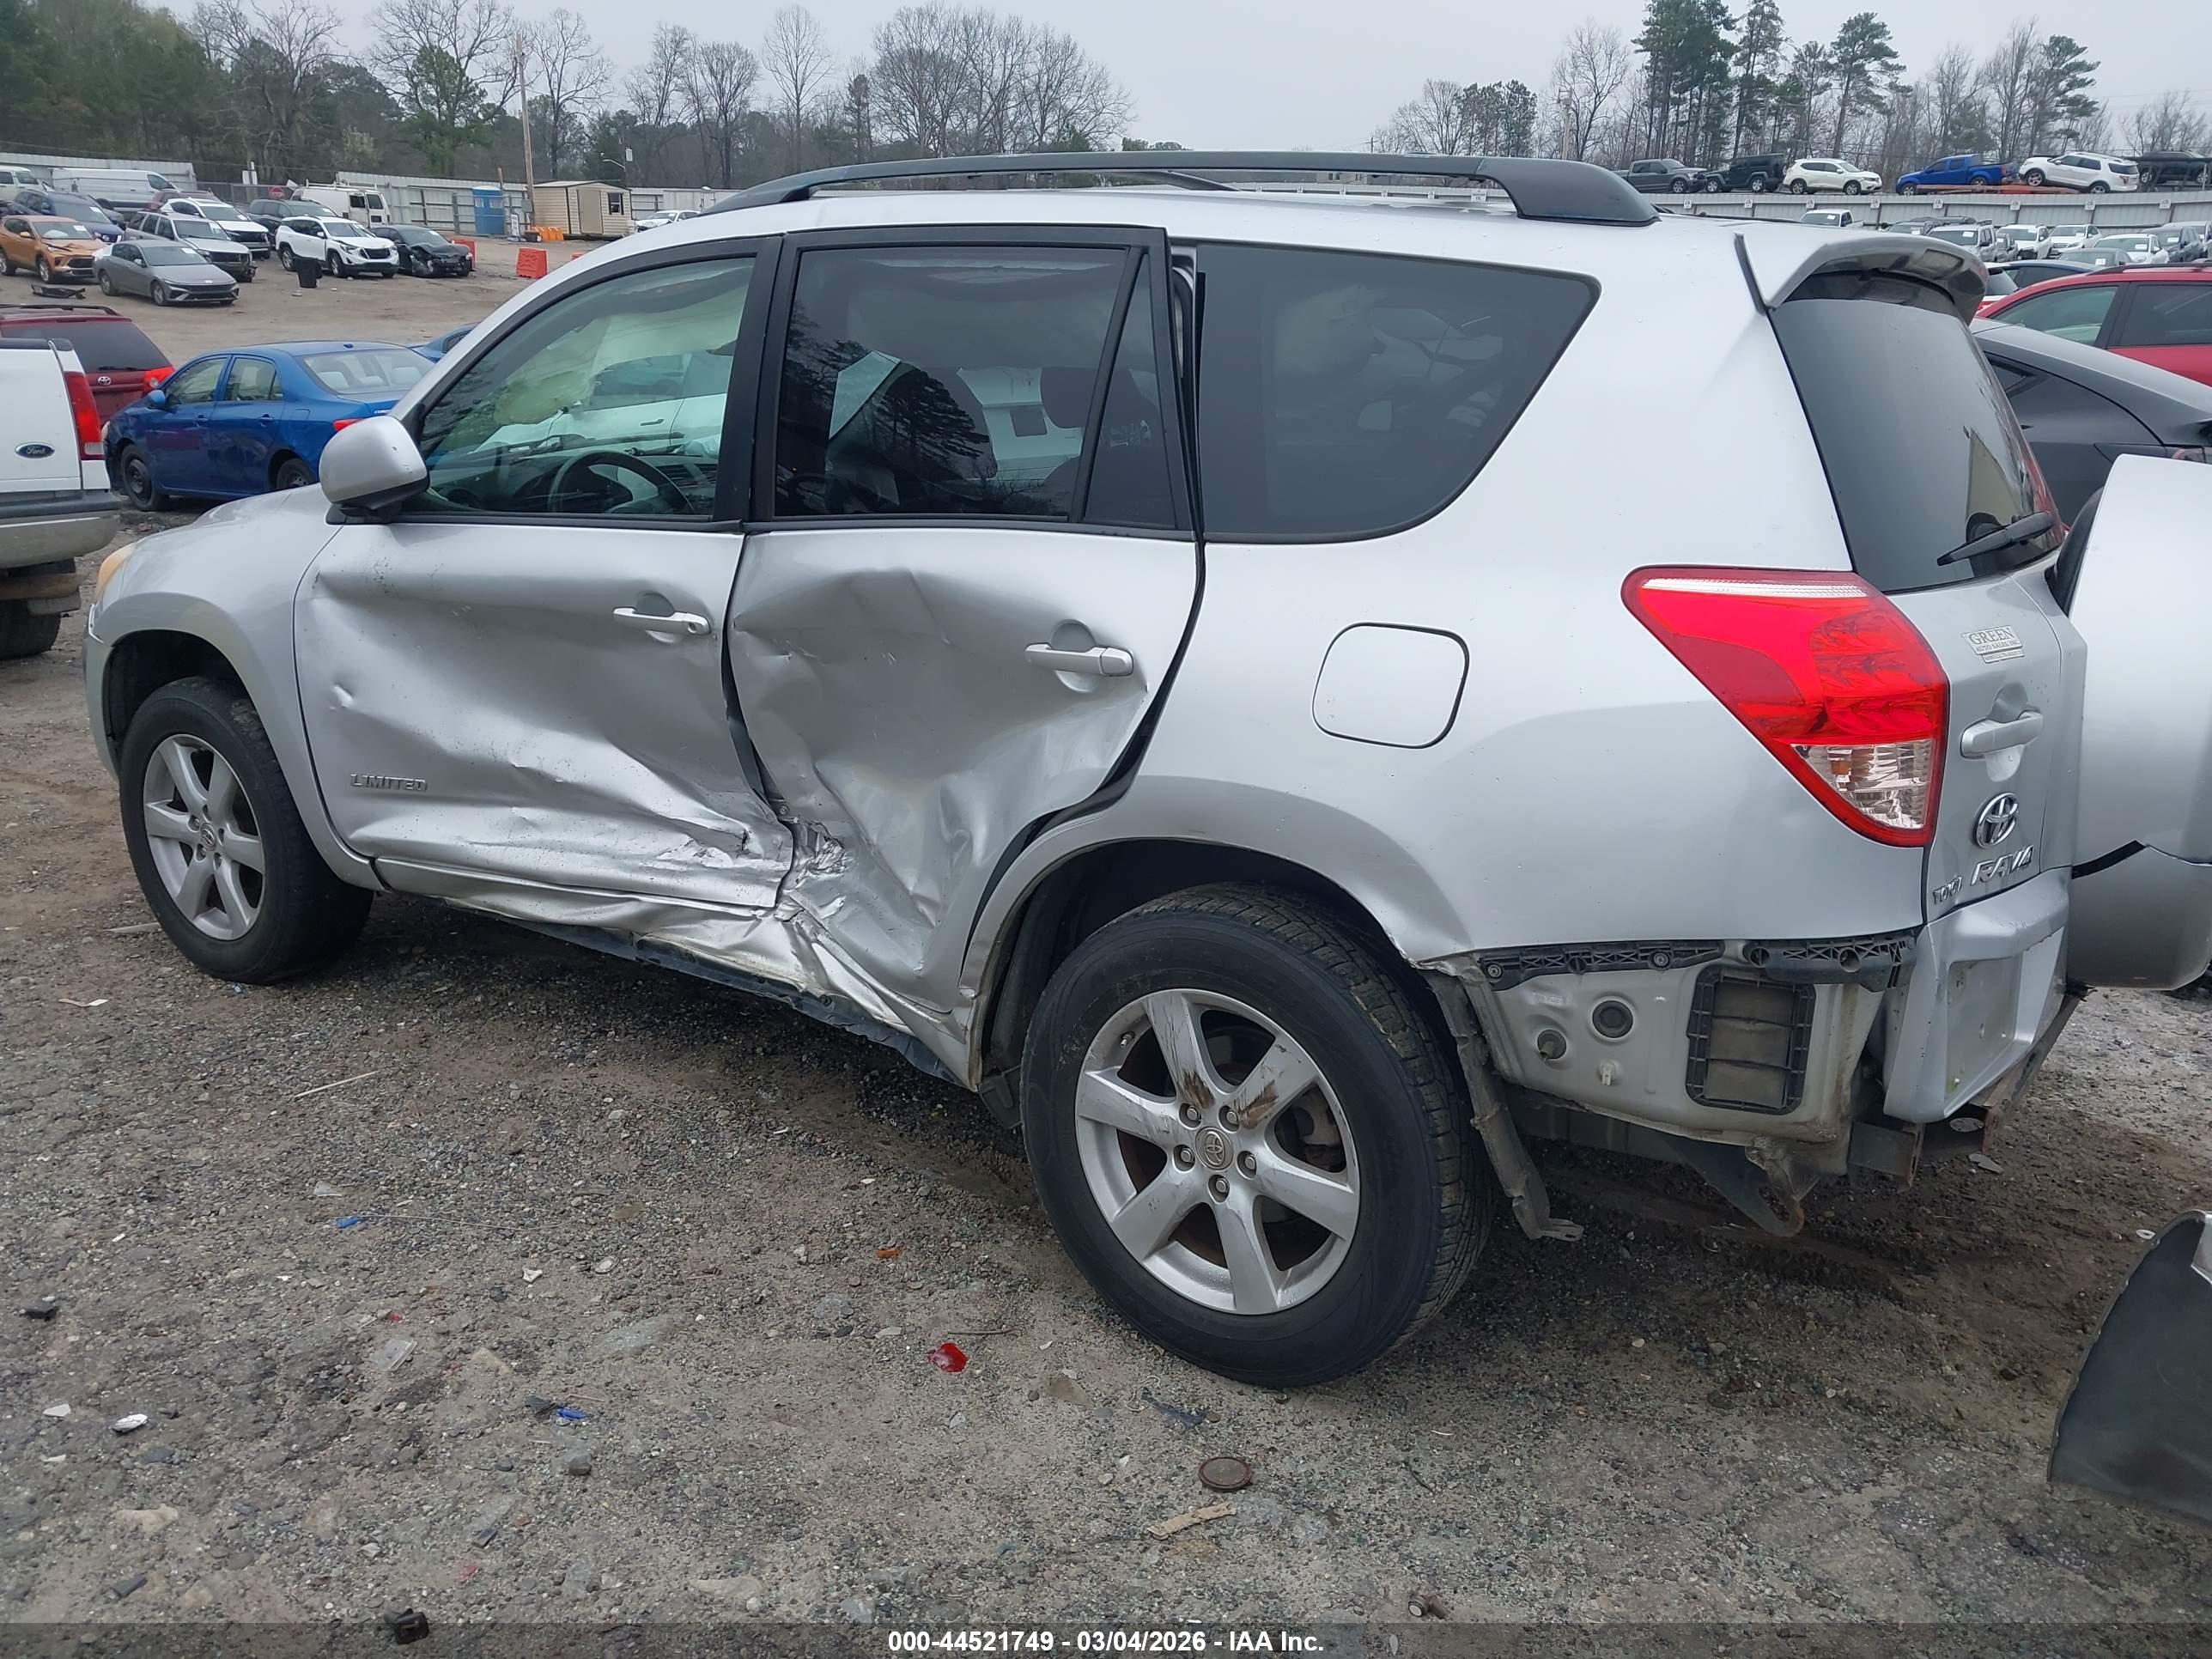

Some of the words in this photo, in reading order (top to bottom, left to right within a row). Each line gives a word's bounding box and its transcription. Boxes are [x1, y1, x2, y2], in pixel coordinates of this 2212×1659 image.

[1969, 627, 2014, 644] GREEN
[350, 773, 428, 791] LIMITED
[1971, 845, 2033, 885] RAV4
